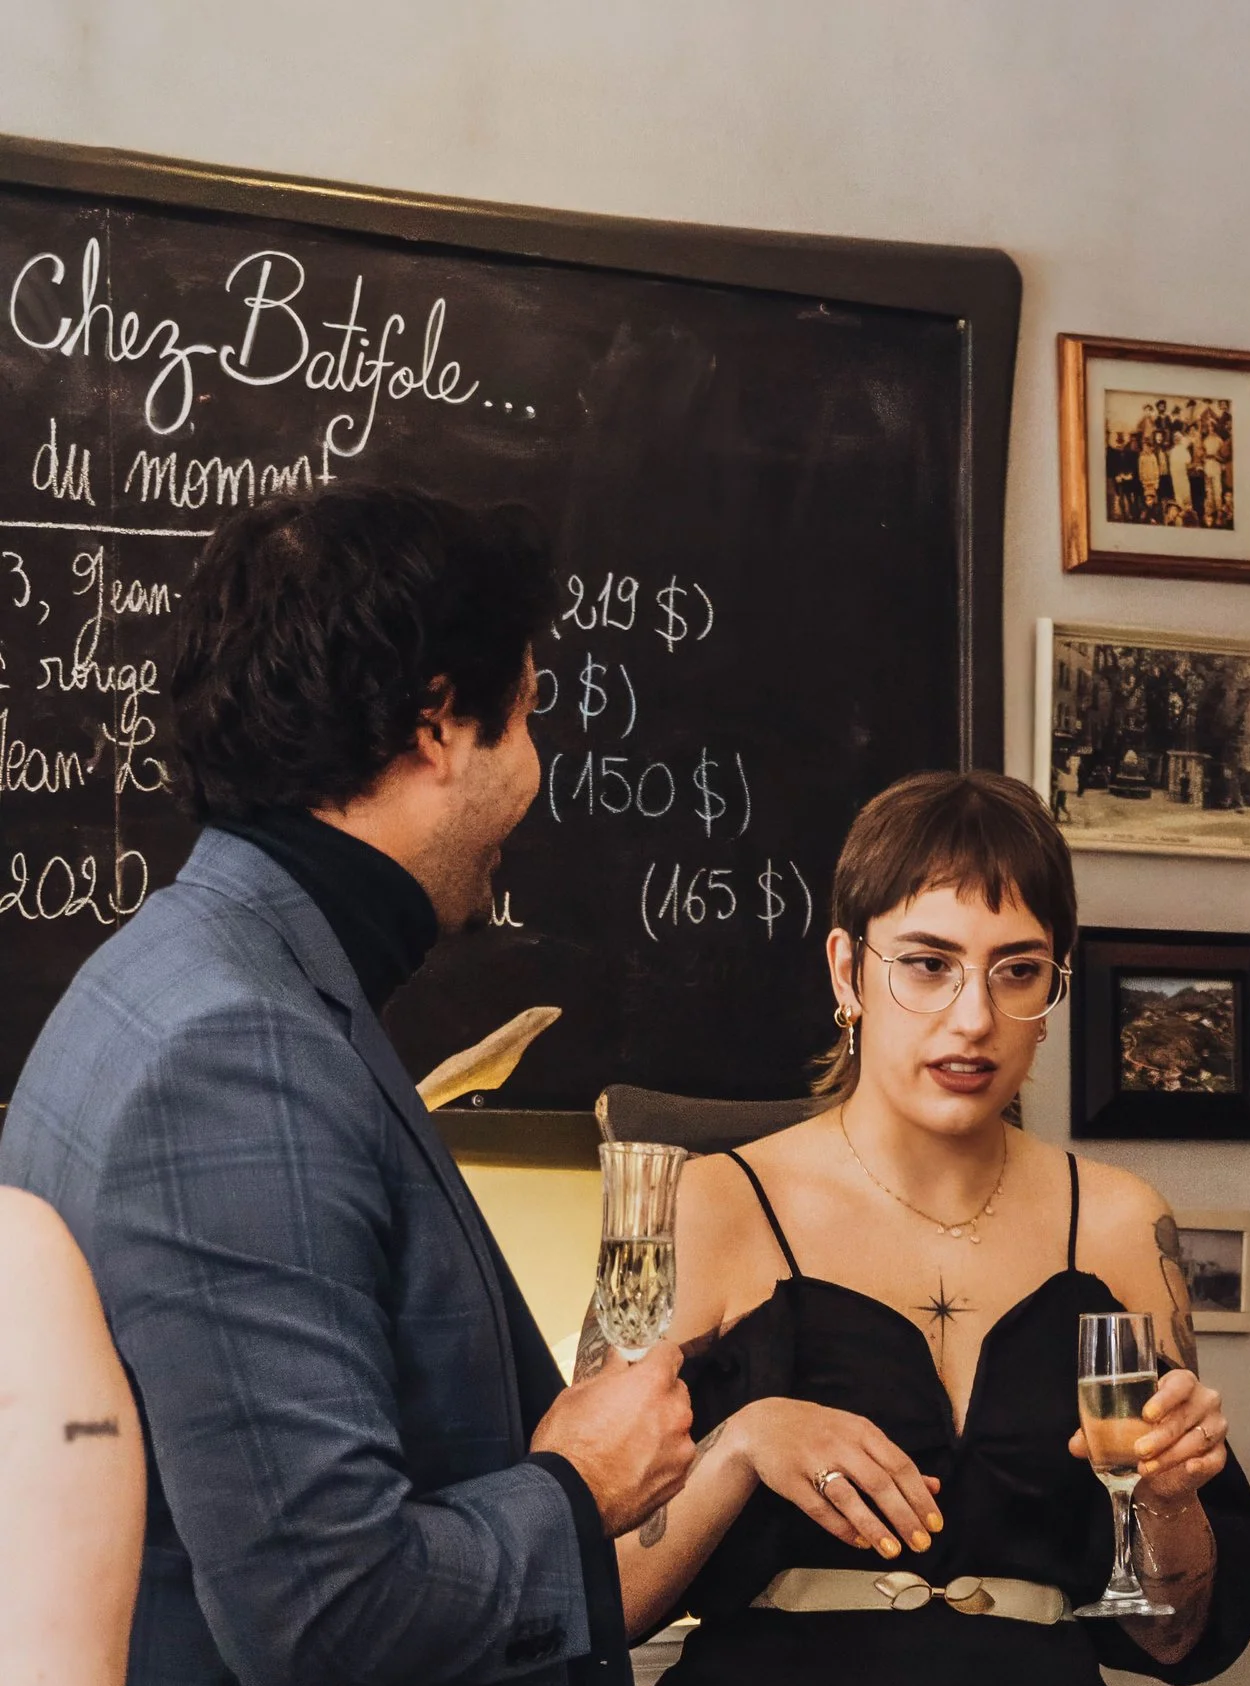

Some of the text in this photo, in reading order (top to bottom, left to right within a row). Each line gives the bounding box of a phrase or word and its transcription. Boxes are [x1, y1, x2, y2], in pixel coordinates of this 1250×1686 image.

[10, 237, 215, 435] Chez
[33, 418, 95, 506] du
[36, 659, 160, 734] rouge
